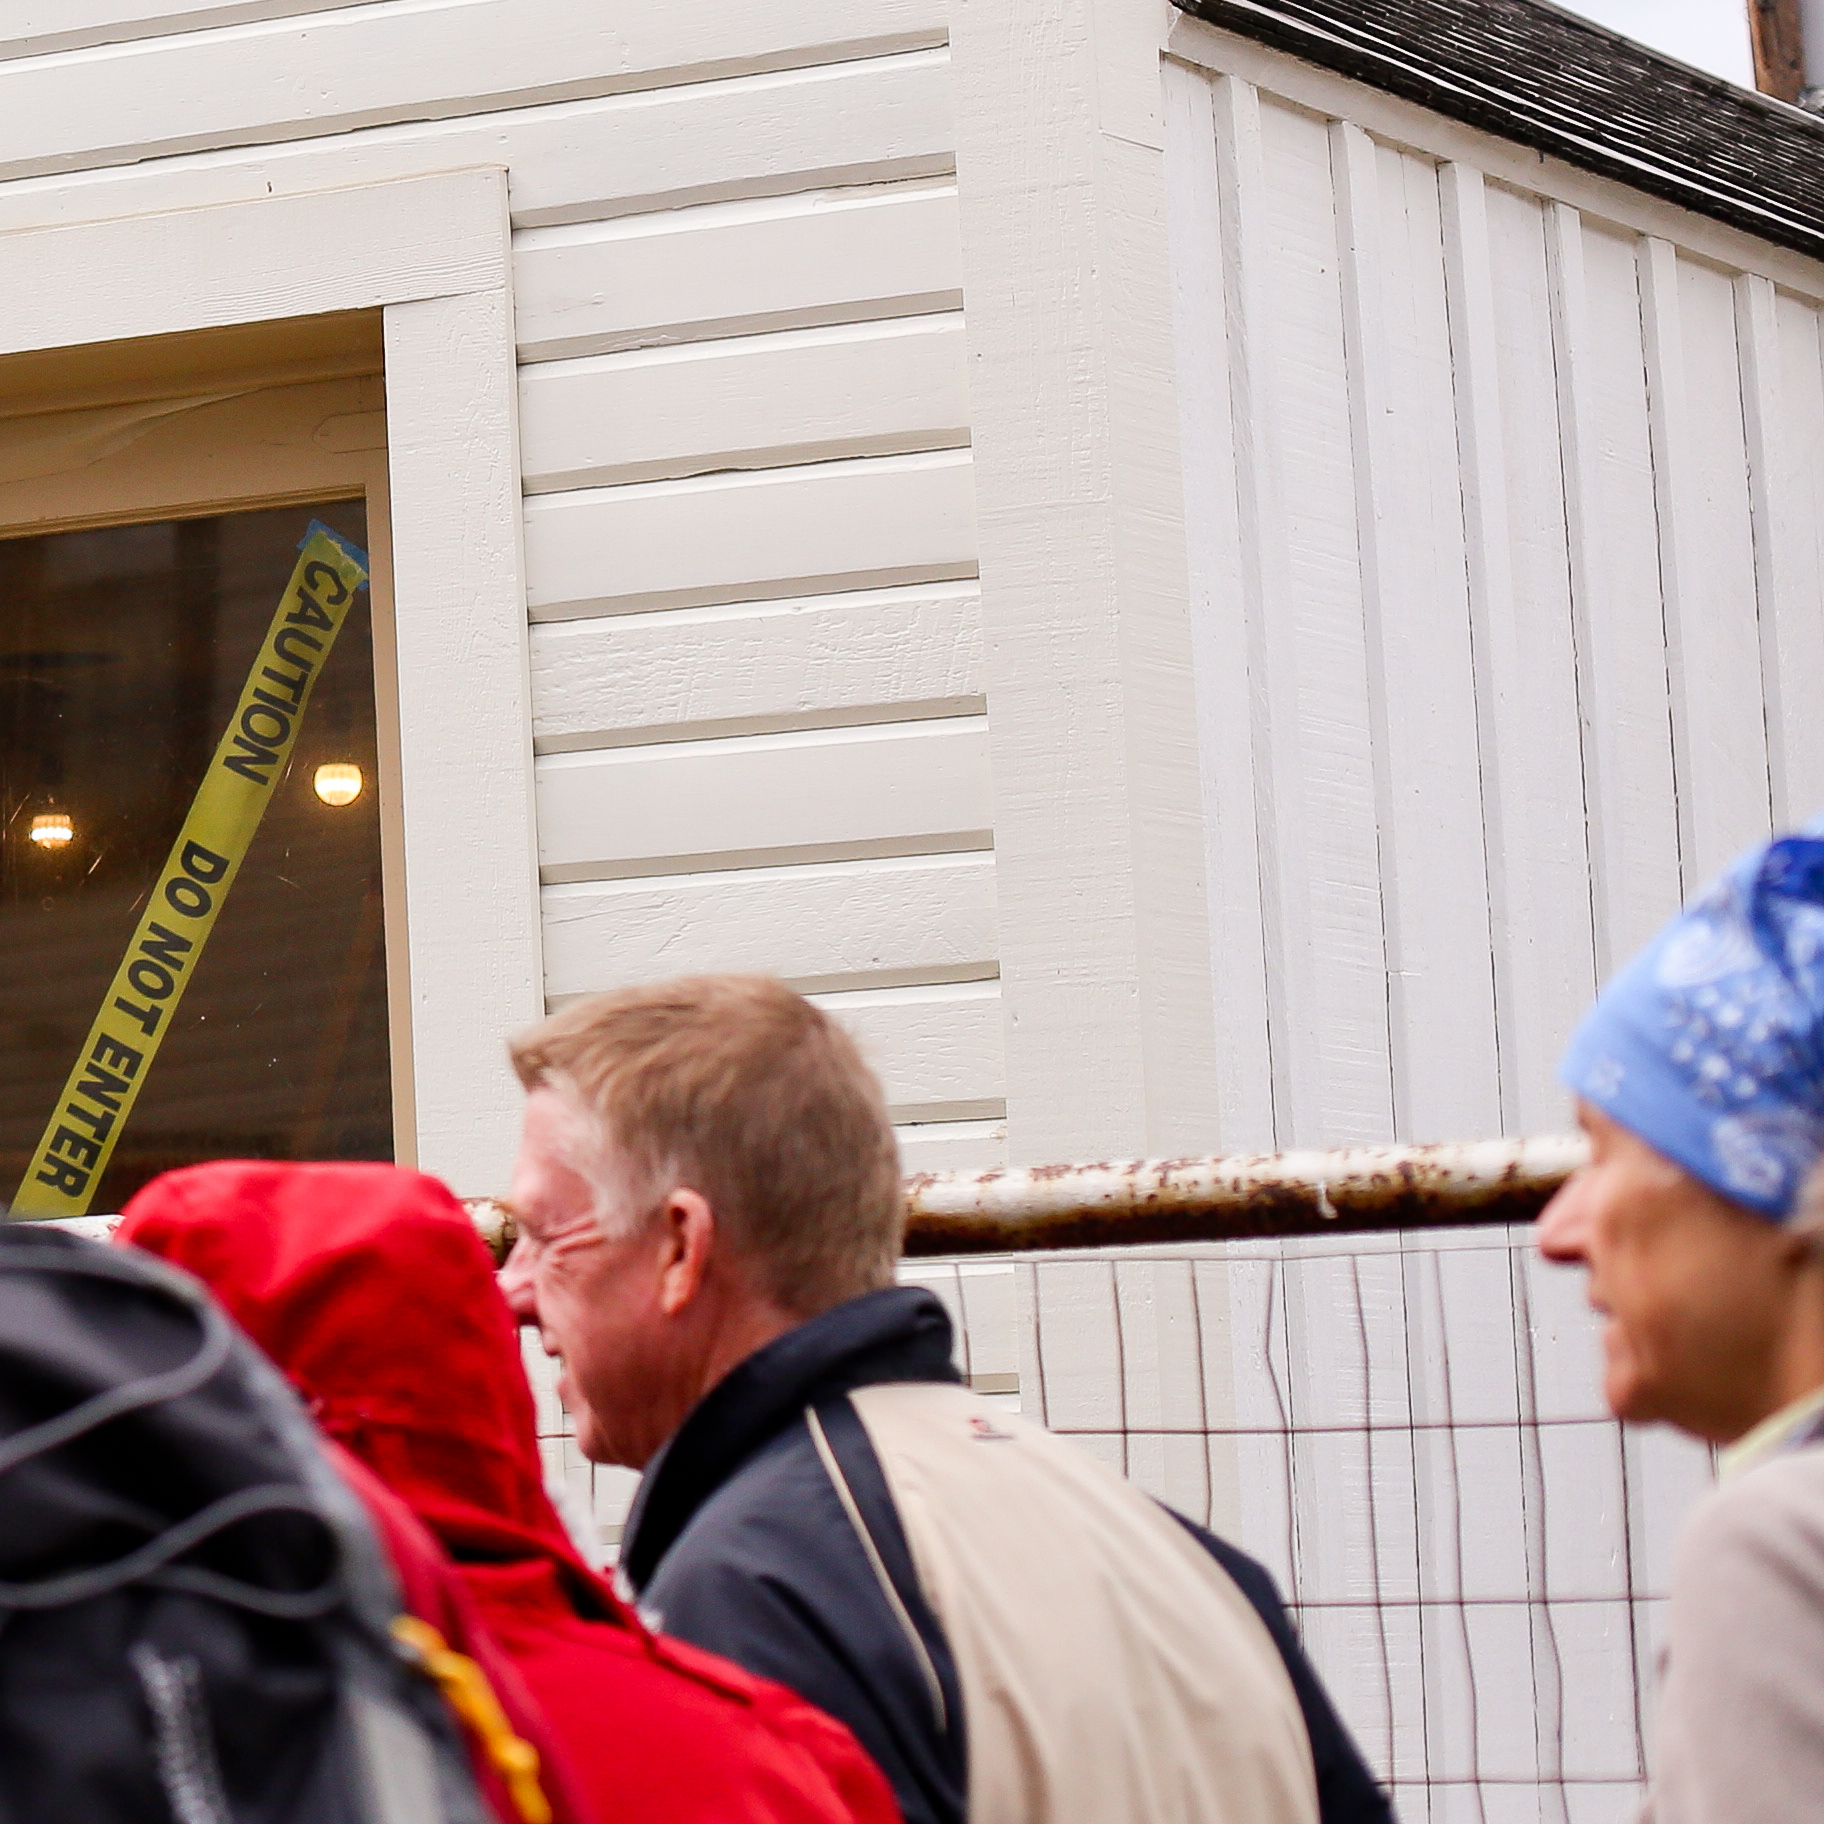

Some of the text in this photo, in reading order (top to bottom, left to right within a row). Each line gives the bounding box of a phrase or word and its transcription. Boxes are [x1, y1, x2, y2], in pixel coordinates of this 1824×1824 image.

[35, 560, 350, 1199] CAUTION DO NOT ENTER
